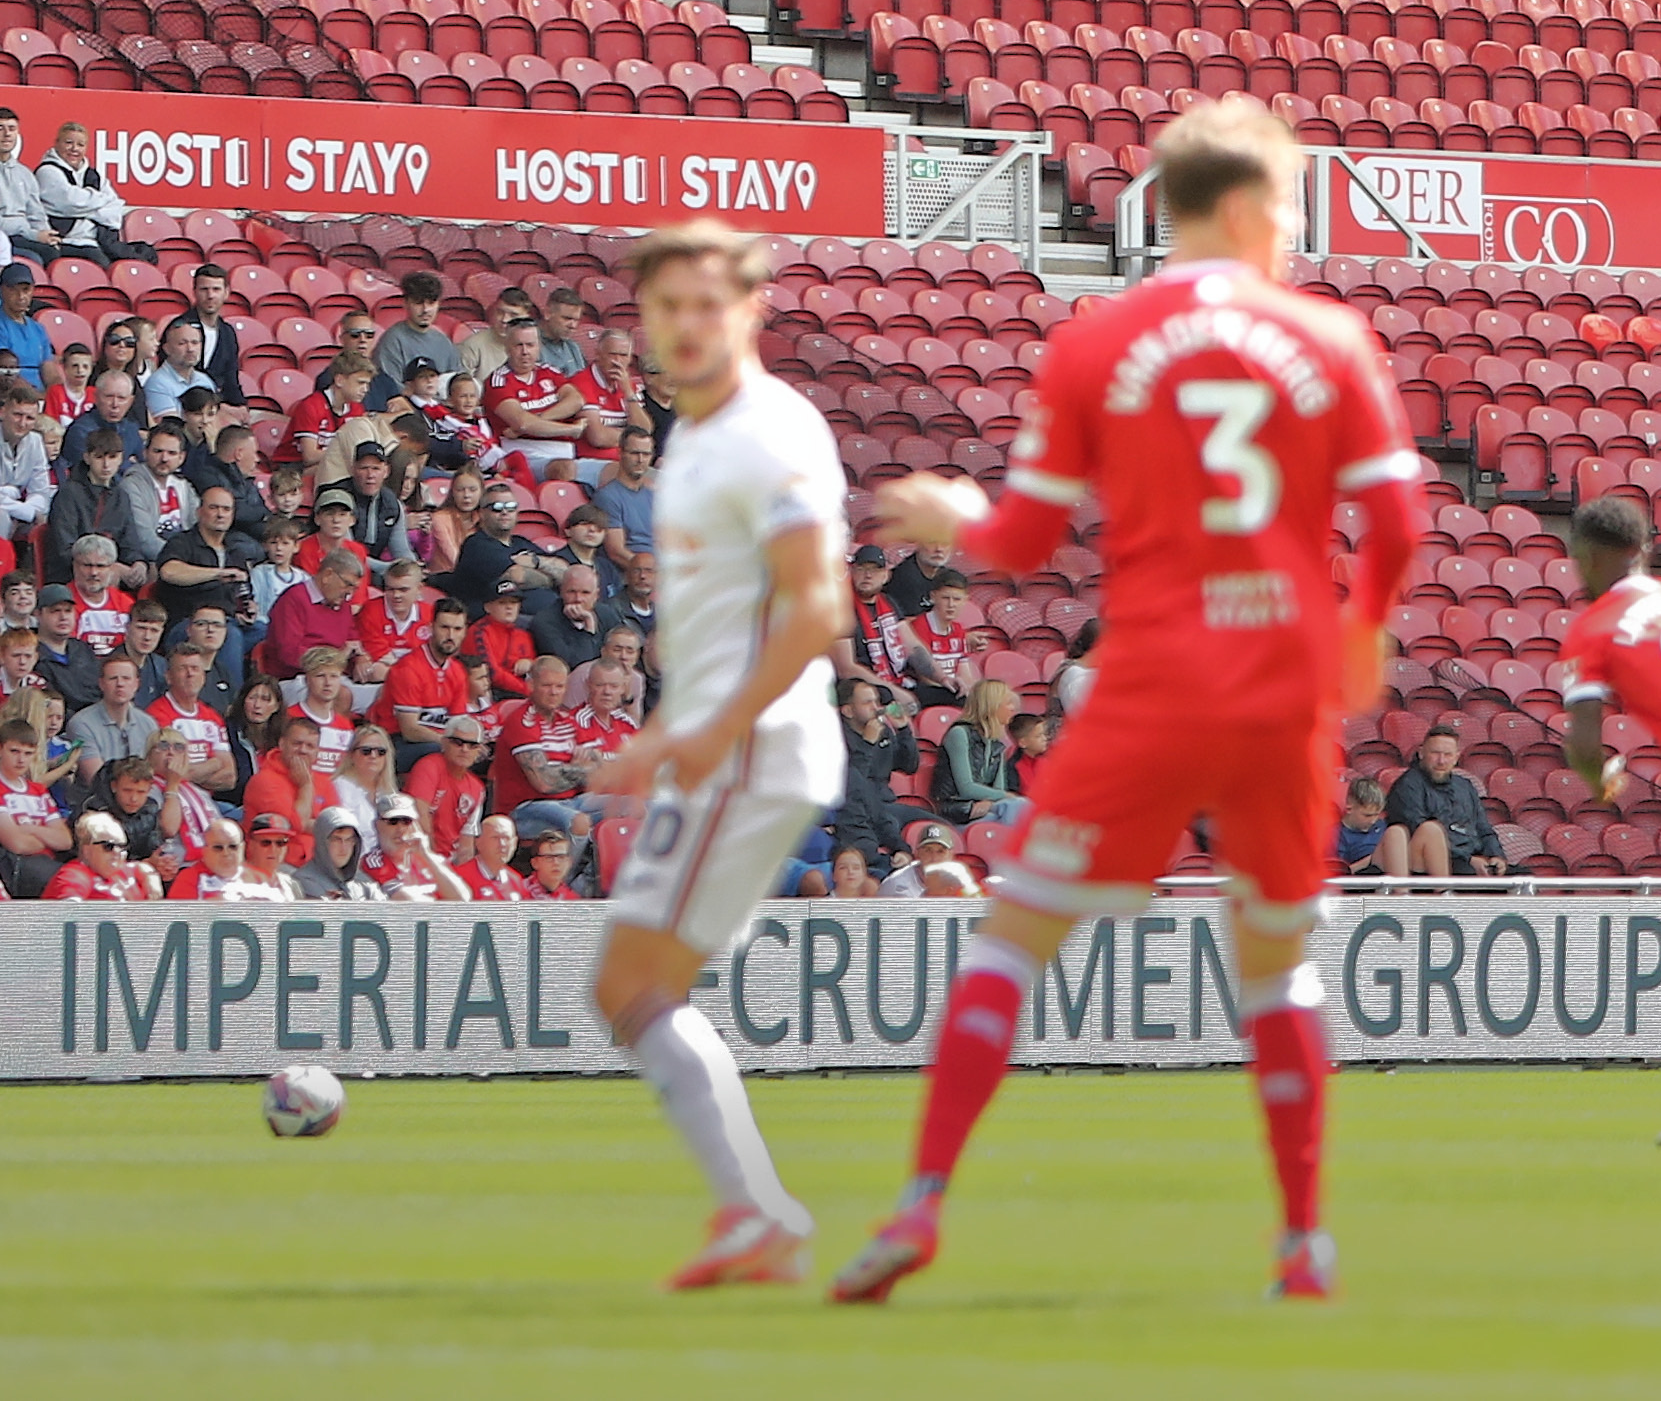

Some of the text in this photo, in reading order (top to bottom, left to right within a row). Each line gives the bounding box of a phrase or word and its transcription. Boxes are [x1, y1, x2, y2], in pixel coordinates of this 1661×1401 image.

[95, 129, 407, 196] HOST STAY
[496, 148, 797, 212] HOST STAY
[1373, 166, 1470, 228] PER
[1503, 204, 1589, 267] CO
[1176, 379, 1283, 535] 3
[60, 919, 572, 1054] IMPERIAL
